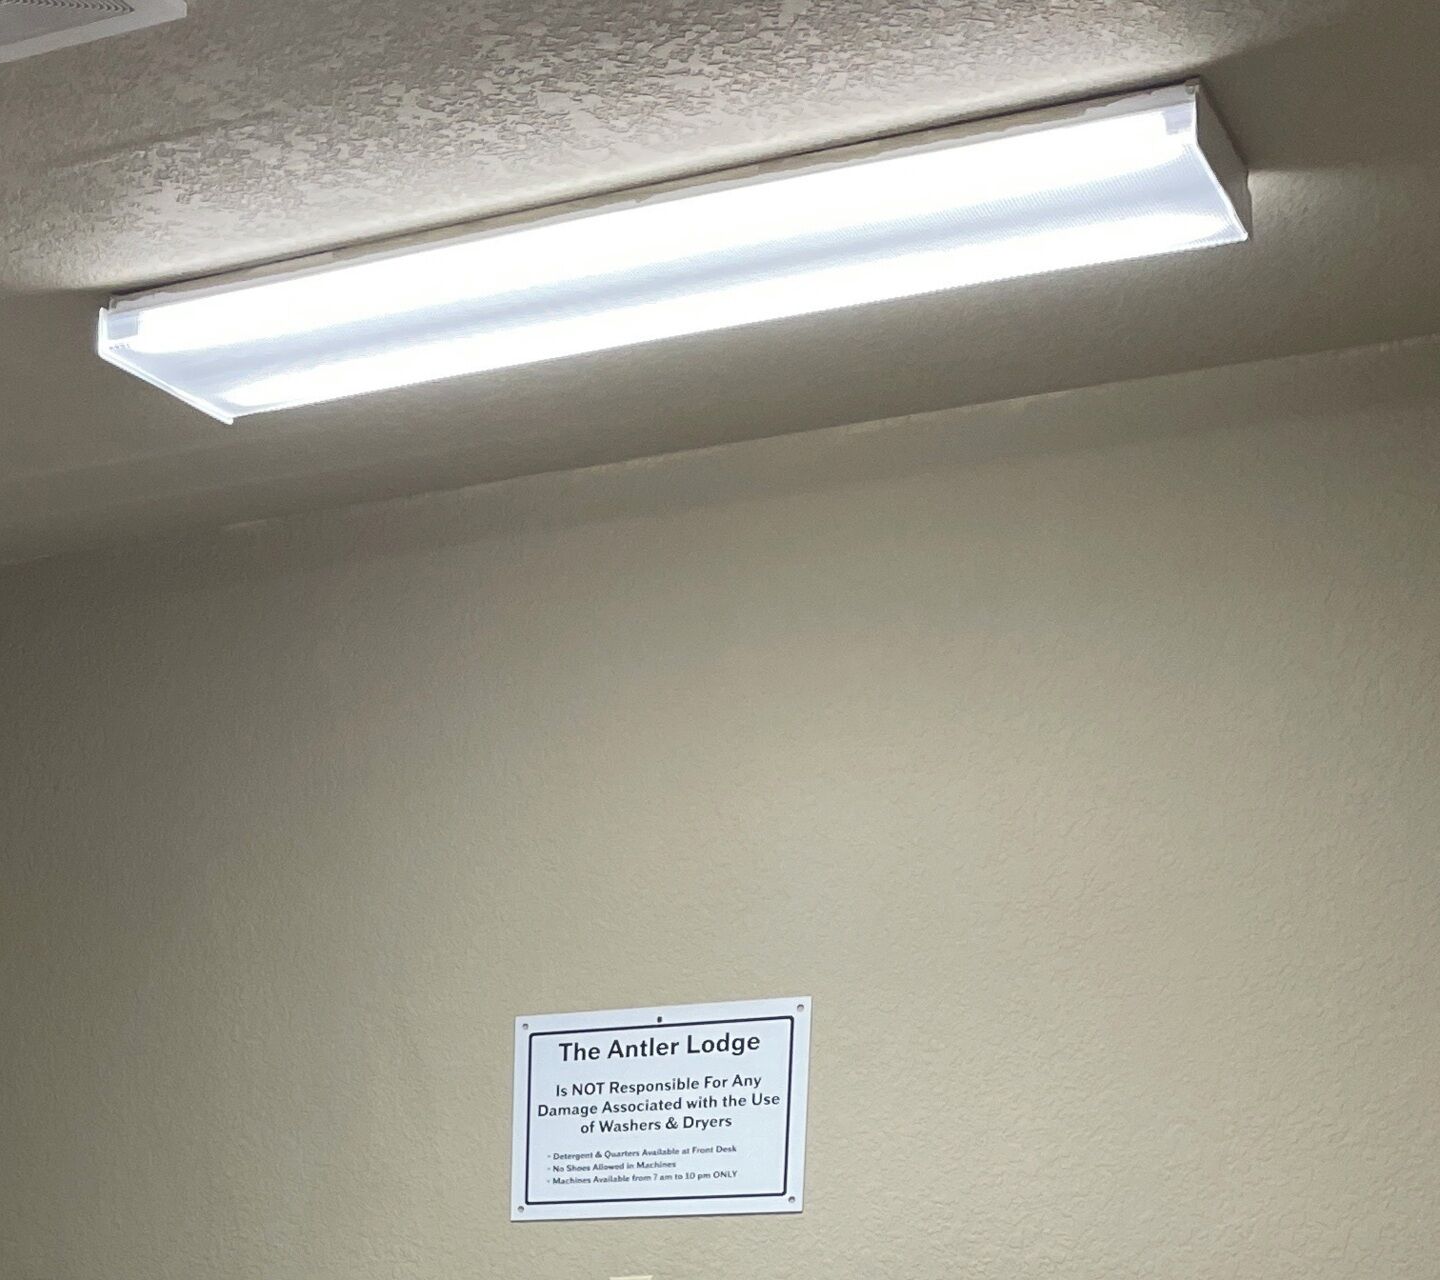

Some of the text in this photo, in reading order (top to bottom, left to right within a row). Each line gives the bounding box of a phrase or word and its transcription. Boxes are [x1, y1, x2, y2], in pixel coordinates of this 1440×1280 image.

[559, 1032, 760, 1062] The Antler Lodge
[556, 1074, 762, 1097] Is NOT Responsible For Any
[537, 1092, 781, 1117] Damage Associated with the Use
[580, 1115, 733, 1134] of Washers & Dryers
[552, 1145, 738, 1161] Detergent & Quarters Available at Front Desk
[552, 1160, 677, 1173] No Shoes Allowed in Machines
[552, 1176, 592, 1185] Machines
[592, 1174, 630, 1184] Available
[631, 1173, 652, 1182] from
[674, 1172, 683, 1180] to
[684, 1171, 696, 1180] 10
[697, 1173, 712, 1182] pm
[712, 1169, 738, 1179] ONLY
